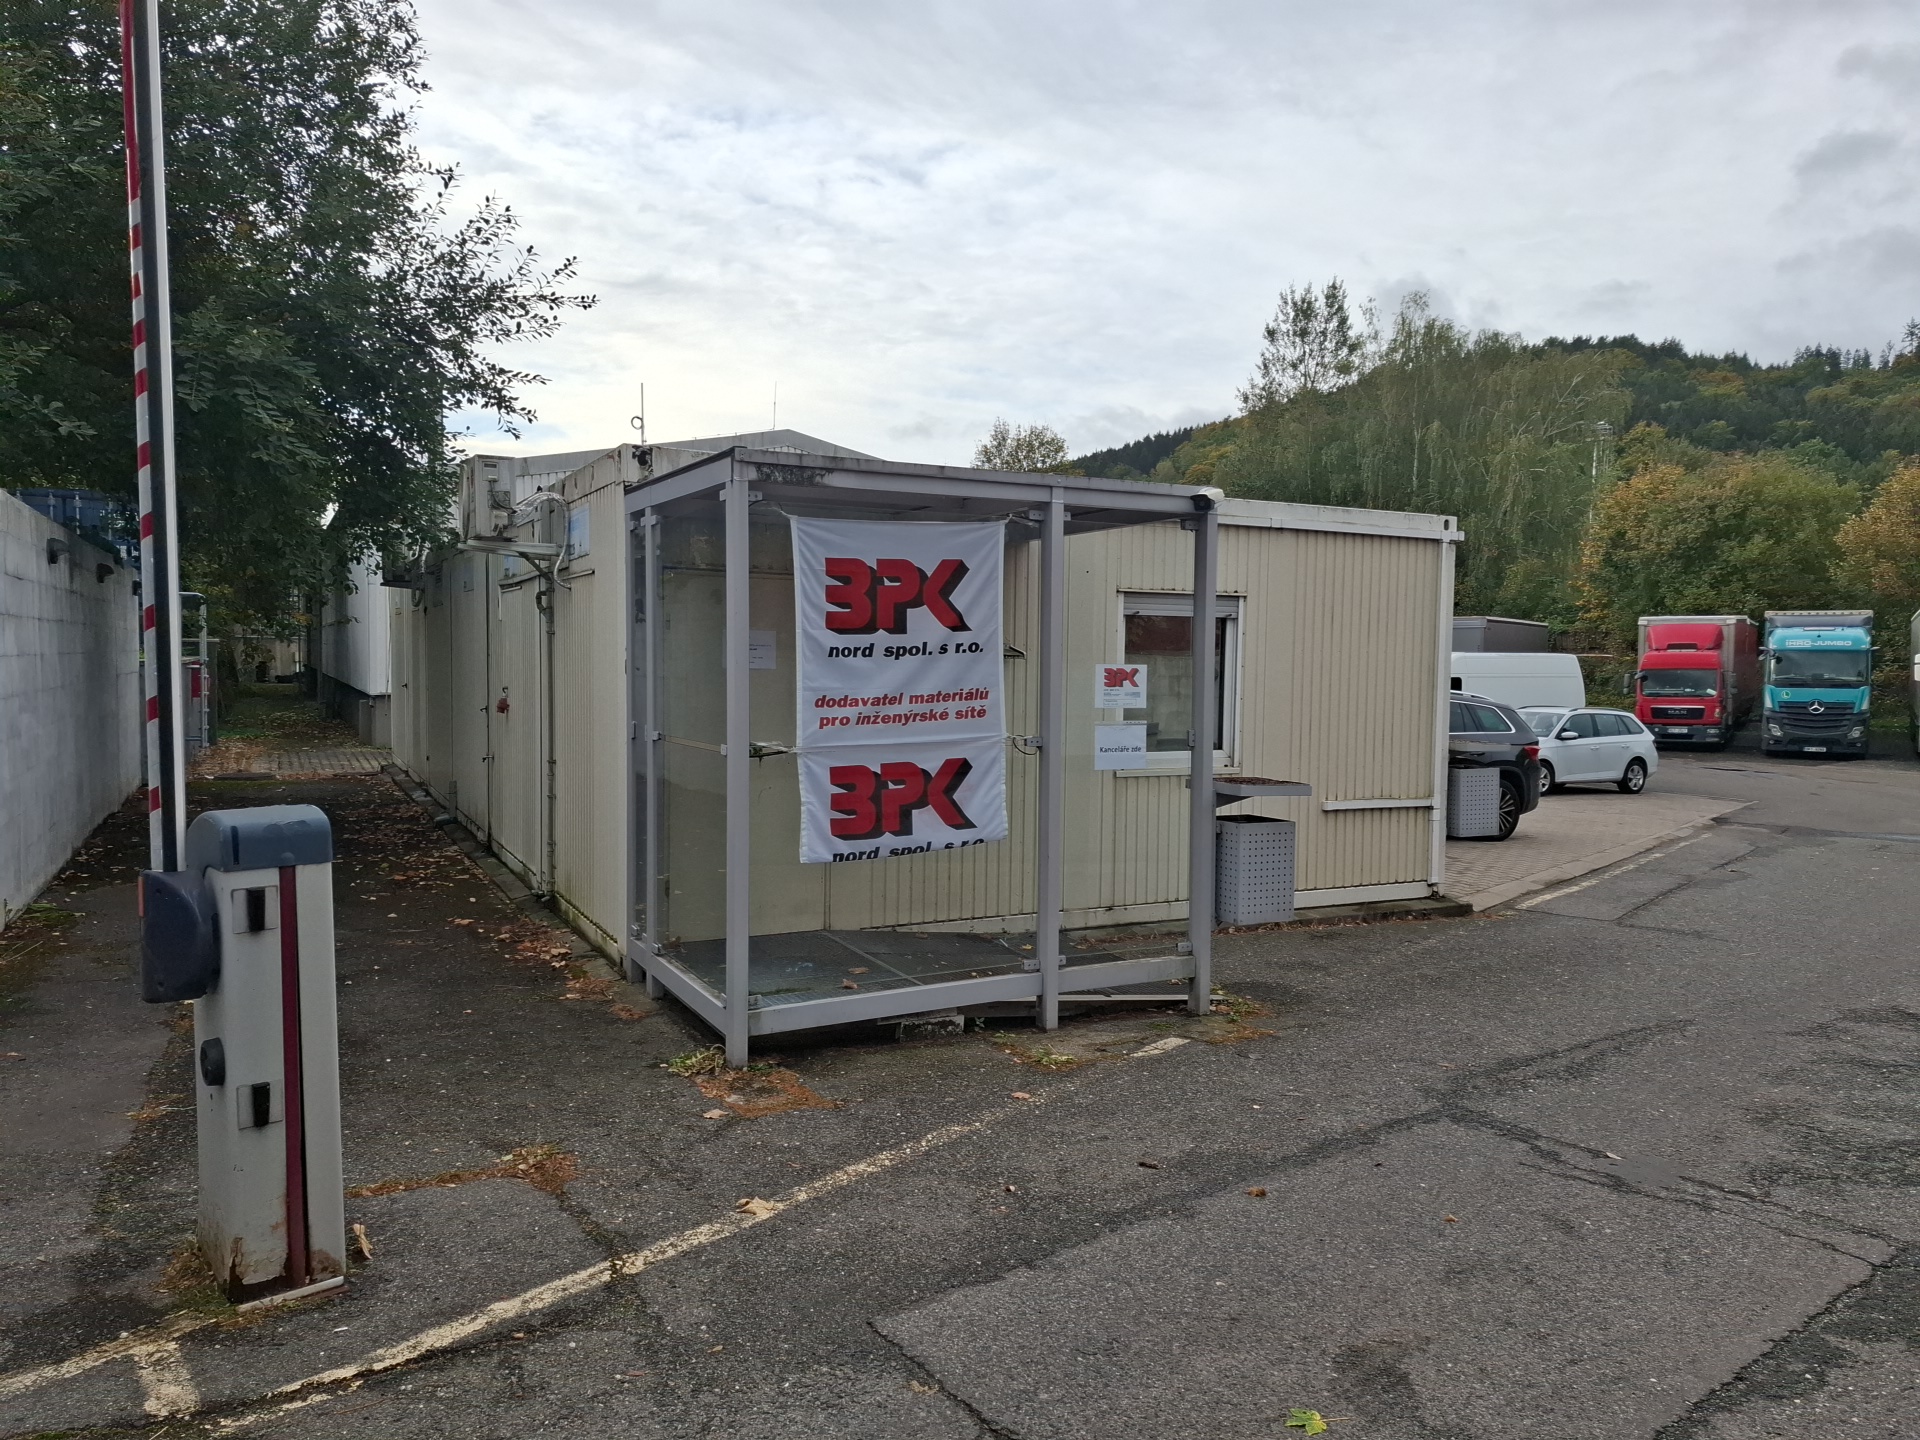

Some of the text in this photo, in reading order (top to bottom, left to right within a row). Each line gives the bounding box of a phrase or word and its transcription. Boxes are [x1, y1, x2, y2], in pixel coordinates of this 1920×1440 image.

[824, 557, 973, 635] BPK
[828, 641, 984, 660] nord spol. s r.o.
[1104, 668, 1140, 688] BPK
[814, 687, 990, 708] dodavatel materiálů
[818, 705, 987, 730] pro inženýrské sítě
[1099, 745, 1142, 753] Kanceláře zde
[829, 757, 978, 842] BPK
[832, 846, 881, 862] nord
